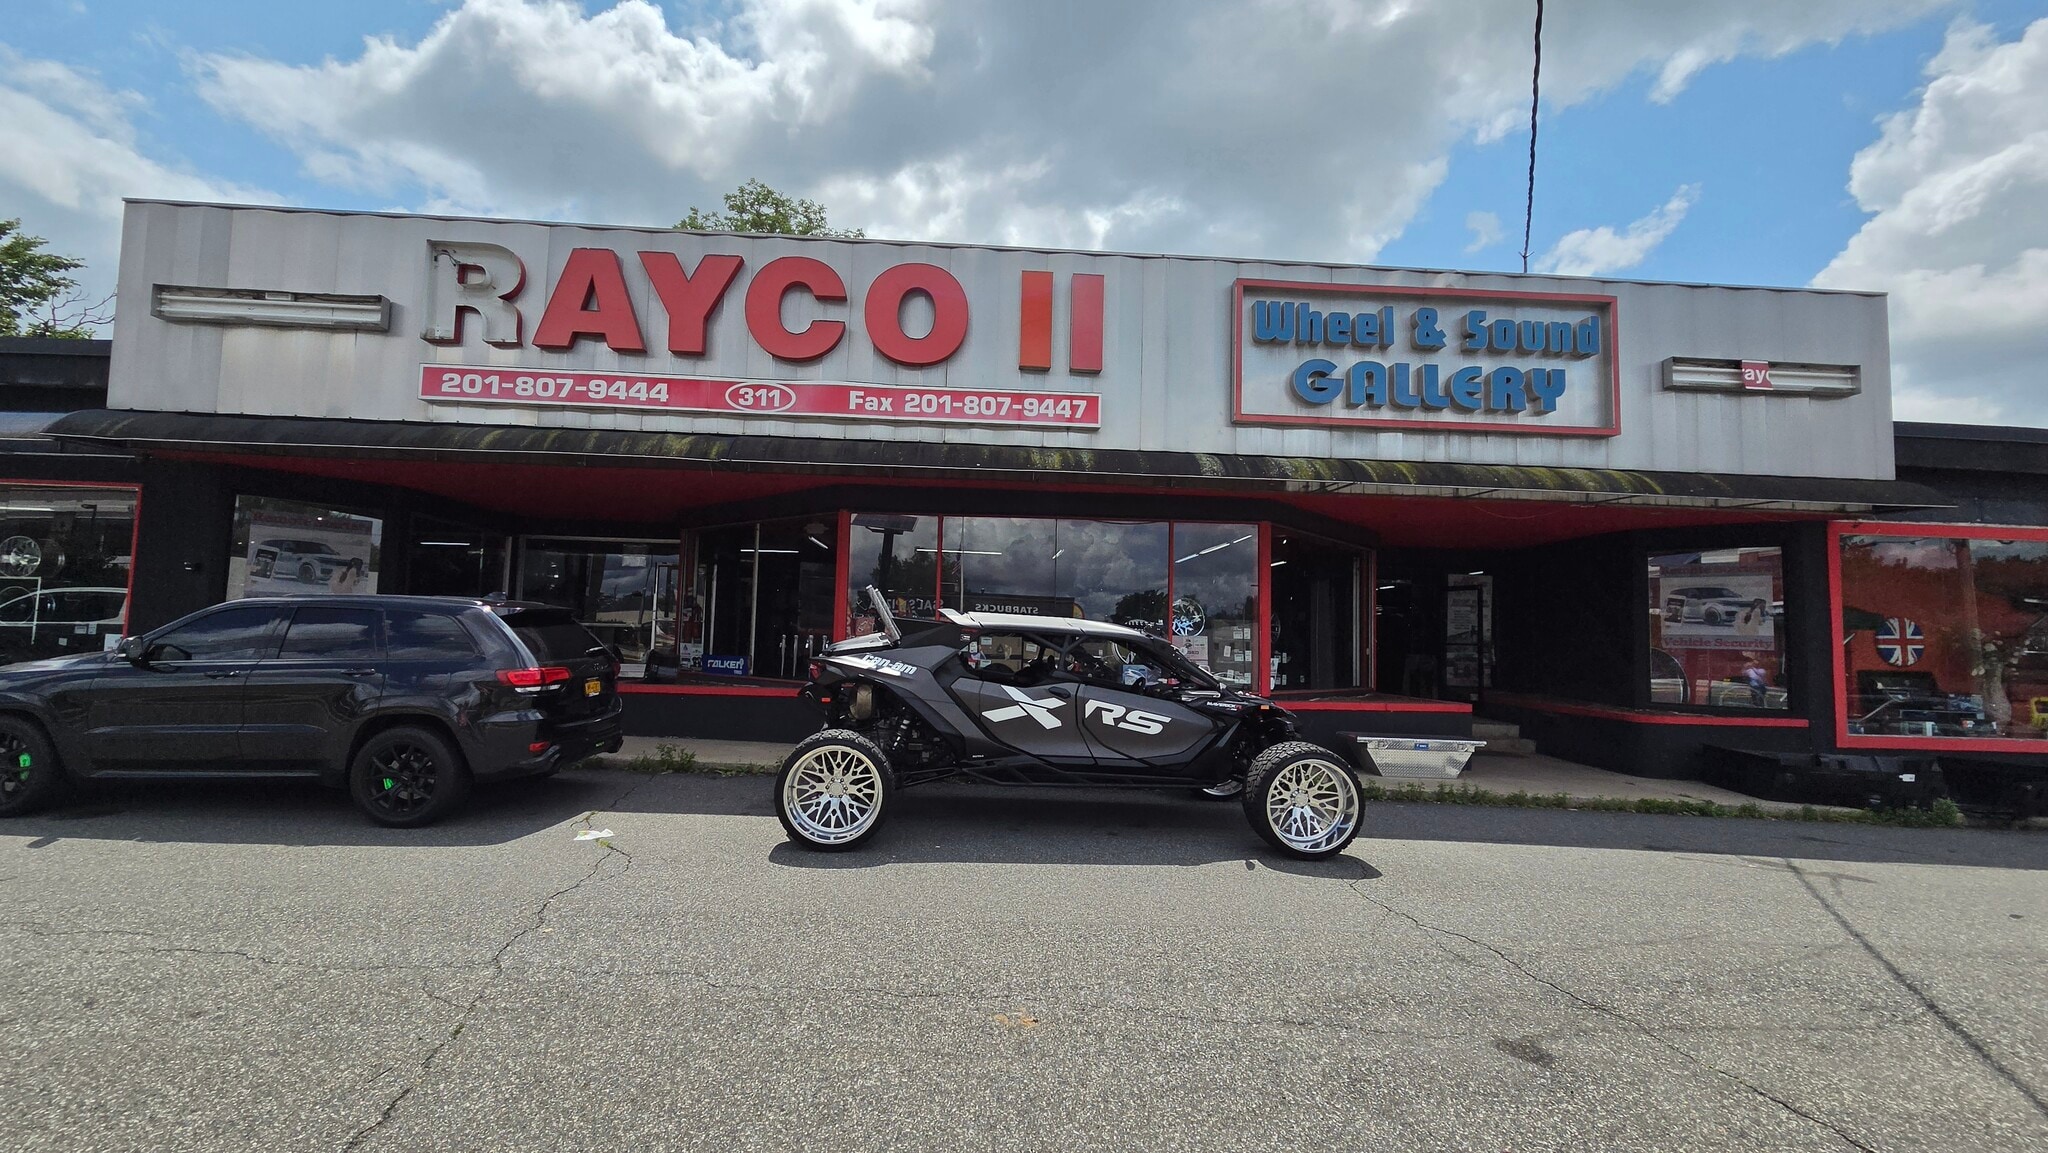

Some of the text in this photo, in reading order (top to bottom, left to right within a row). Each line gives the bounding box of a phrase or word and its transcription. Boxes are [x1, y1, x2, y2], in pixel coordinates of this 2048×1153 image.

[421, 239, 1104, 373] RAYCO II
[1252, 300, 1599, 357] Wheel & Sound
[441, 373, 1087, 419] 201-807-9444 311 Fax 201-807-9447
[1292, 358, 1566, 412] GALLERY
[1663, 636, 1773, 650] Vehicle Security
[1084, 699, 1172, 735] RS
